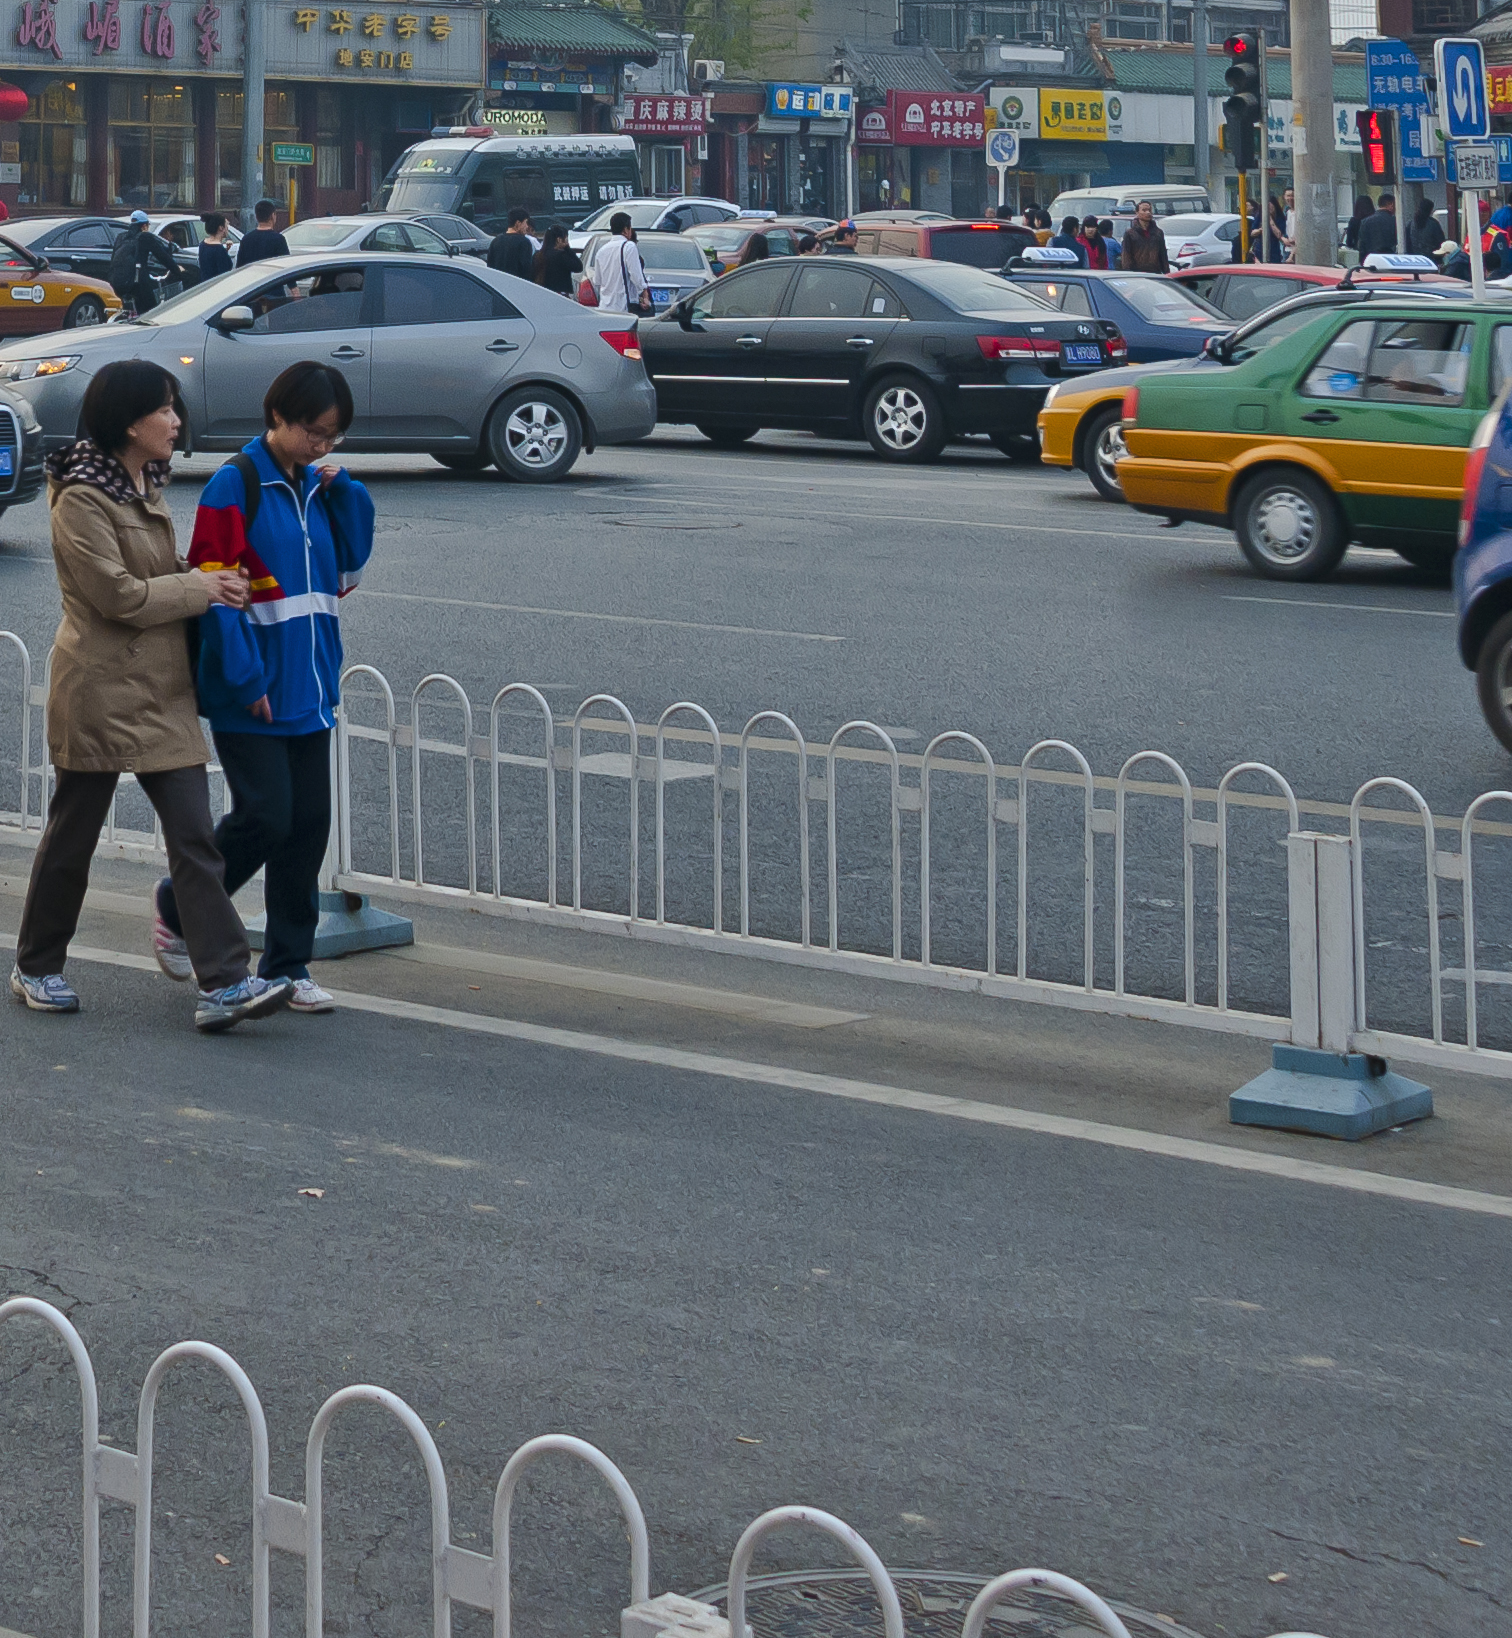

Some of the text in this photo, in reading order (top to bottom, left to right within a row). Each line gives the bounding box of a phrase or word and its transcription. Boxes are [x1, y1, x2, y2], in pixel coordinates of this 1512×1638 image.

[296, 8, 453, 42] 中华老字号
[337, 48, 414, 70] 地安门店
[482, 111, 548, 125] UROMODA
[624, 99, 703, 121] 重庆麻辣烫
[930, 99, 976, 117] 北京特产
